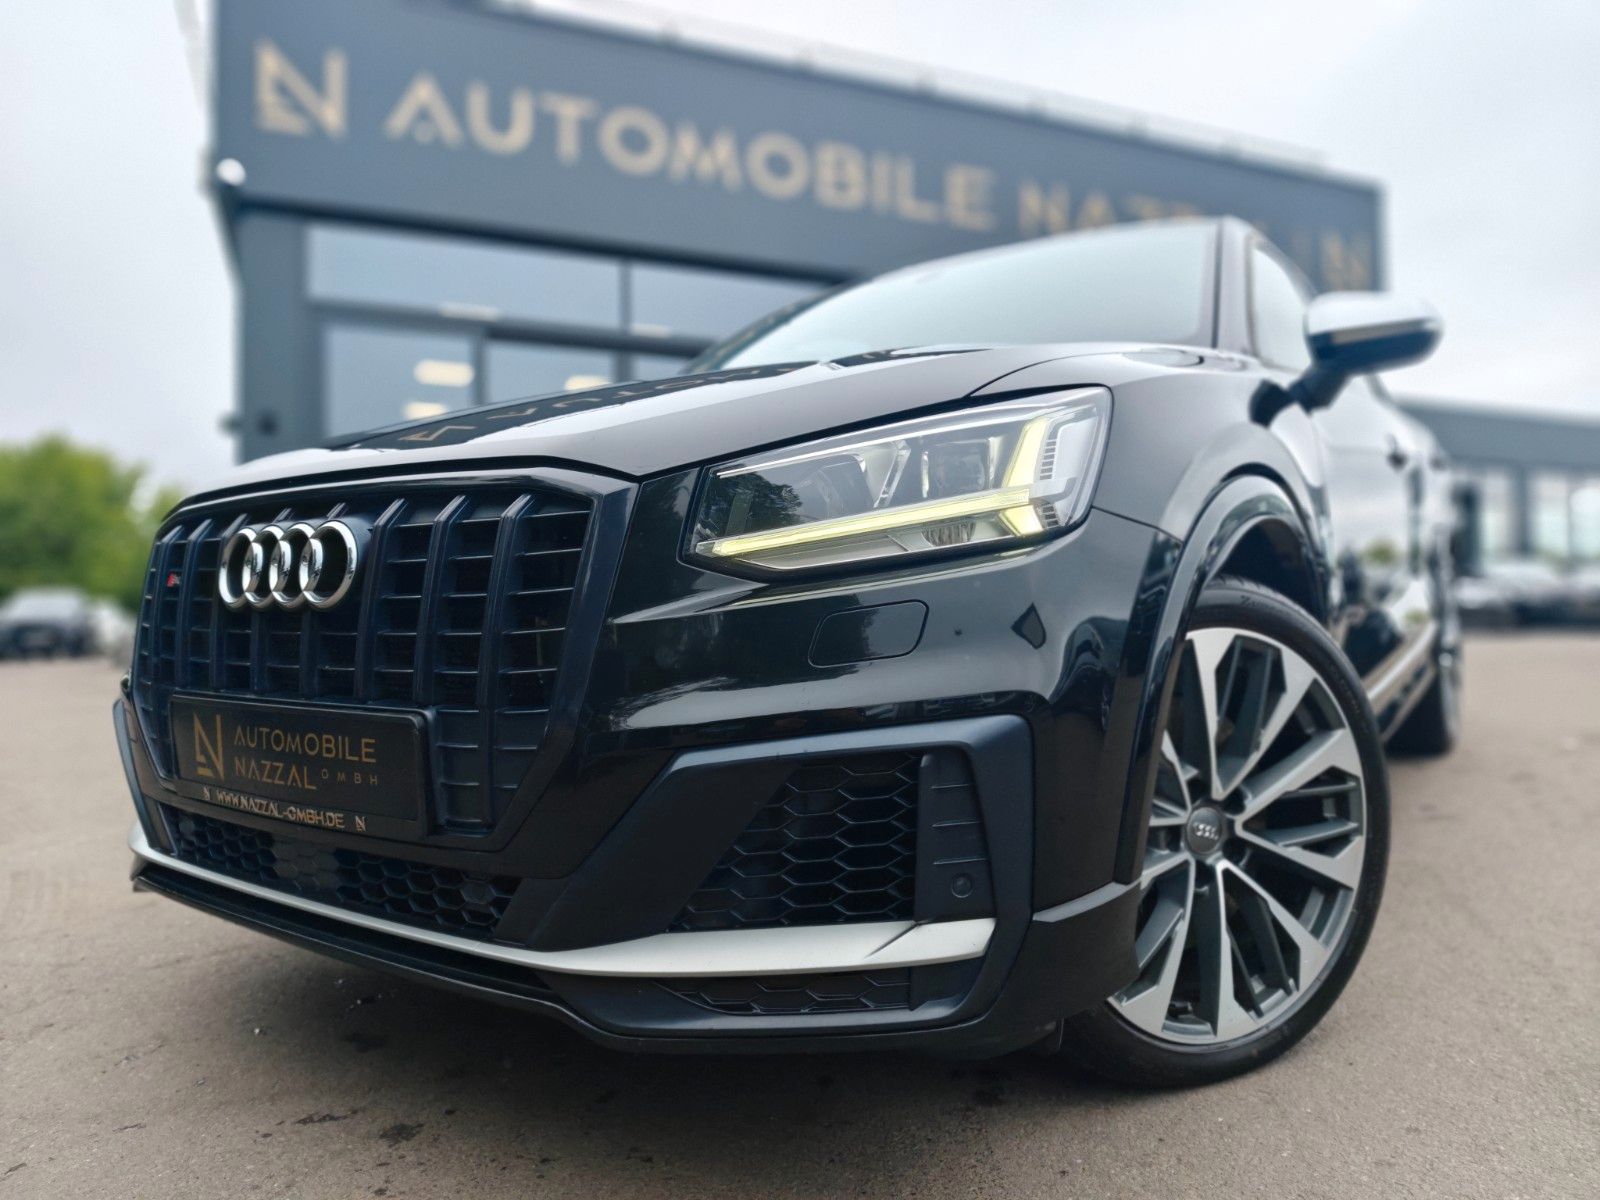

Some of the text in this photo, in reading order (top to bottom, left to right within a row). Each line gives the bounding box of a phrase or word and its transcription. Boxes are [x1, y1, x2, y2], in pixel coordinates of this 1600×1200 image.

[383, 70, 997, 233] AUTOMOBILE
[233, 725, 377, 764] AUTOMOBILE
[234, 756, 317, 790] NAZZAL
